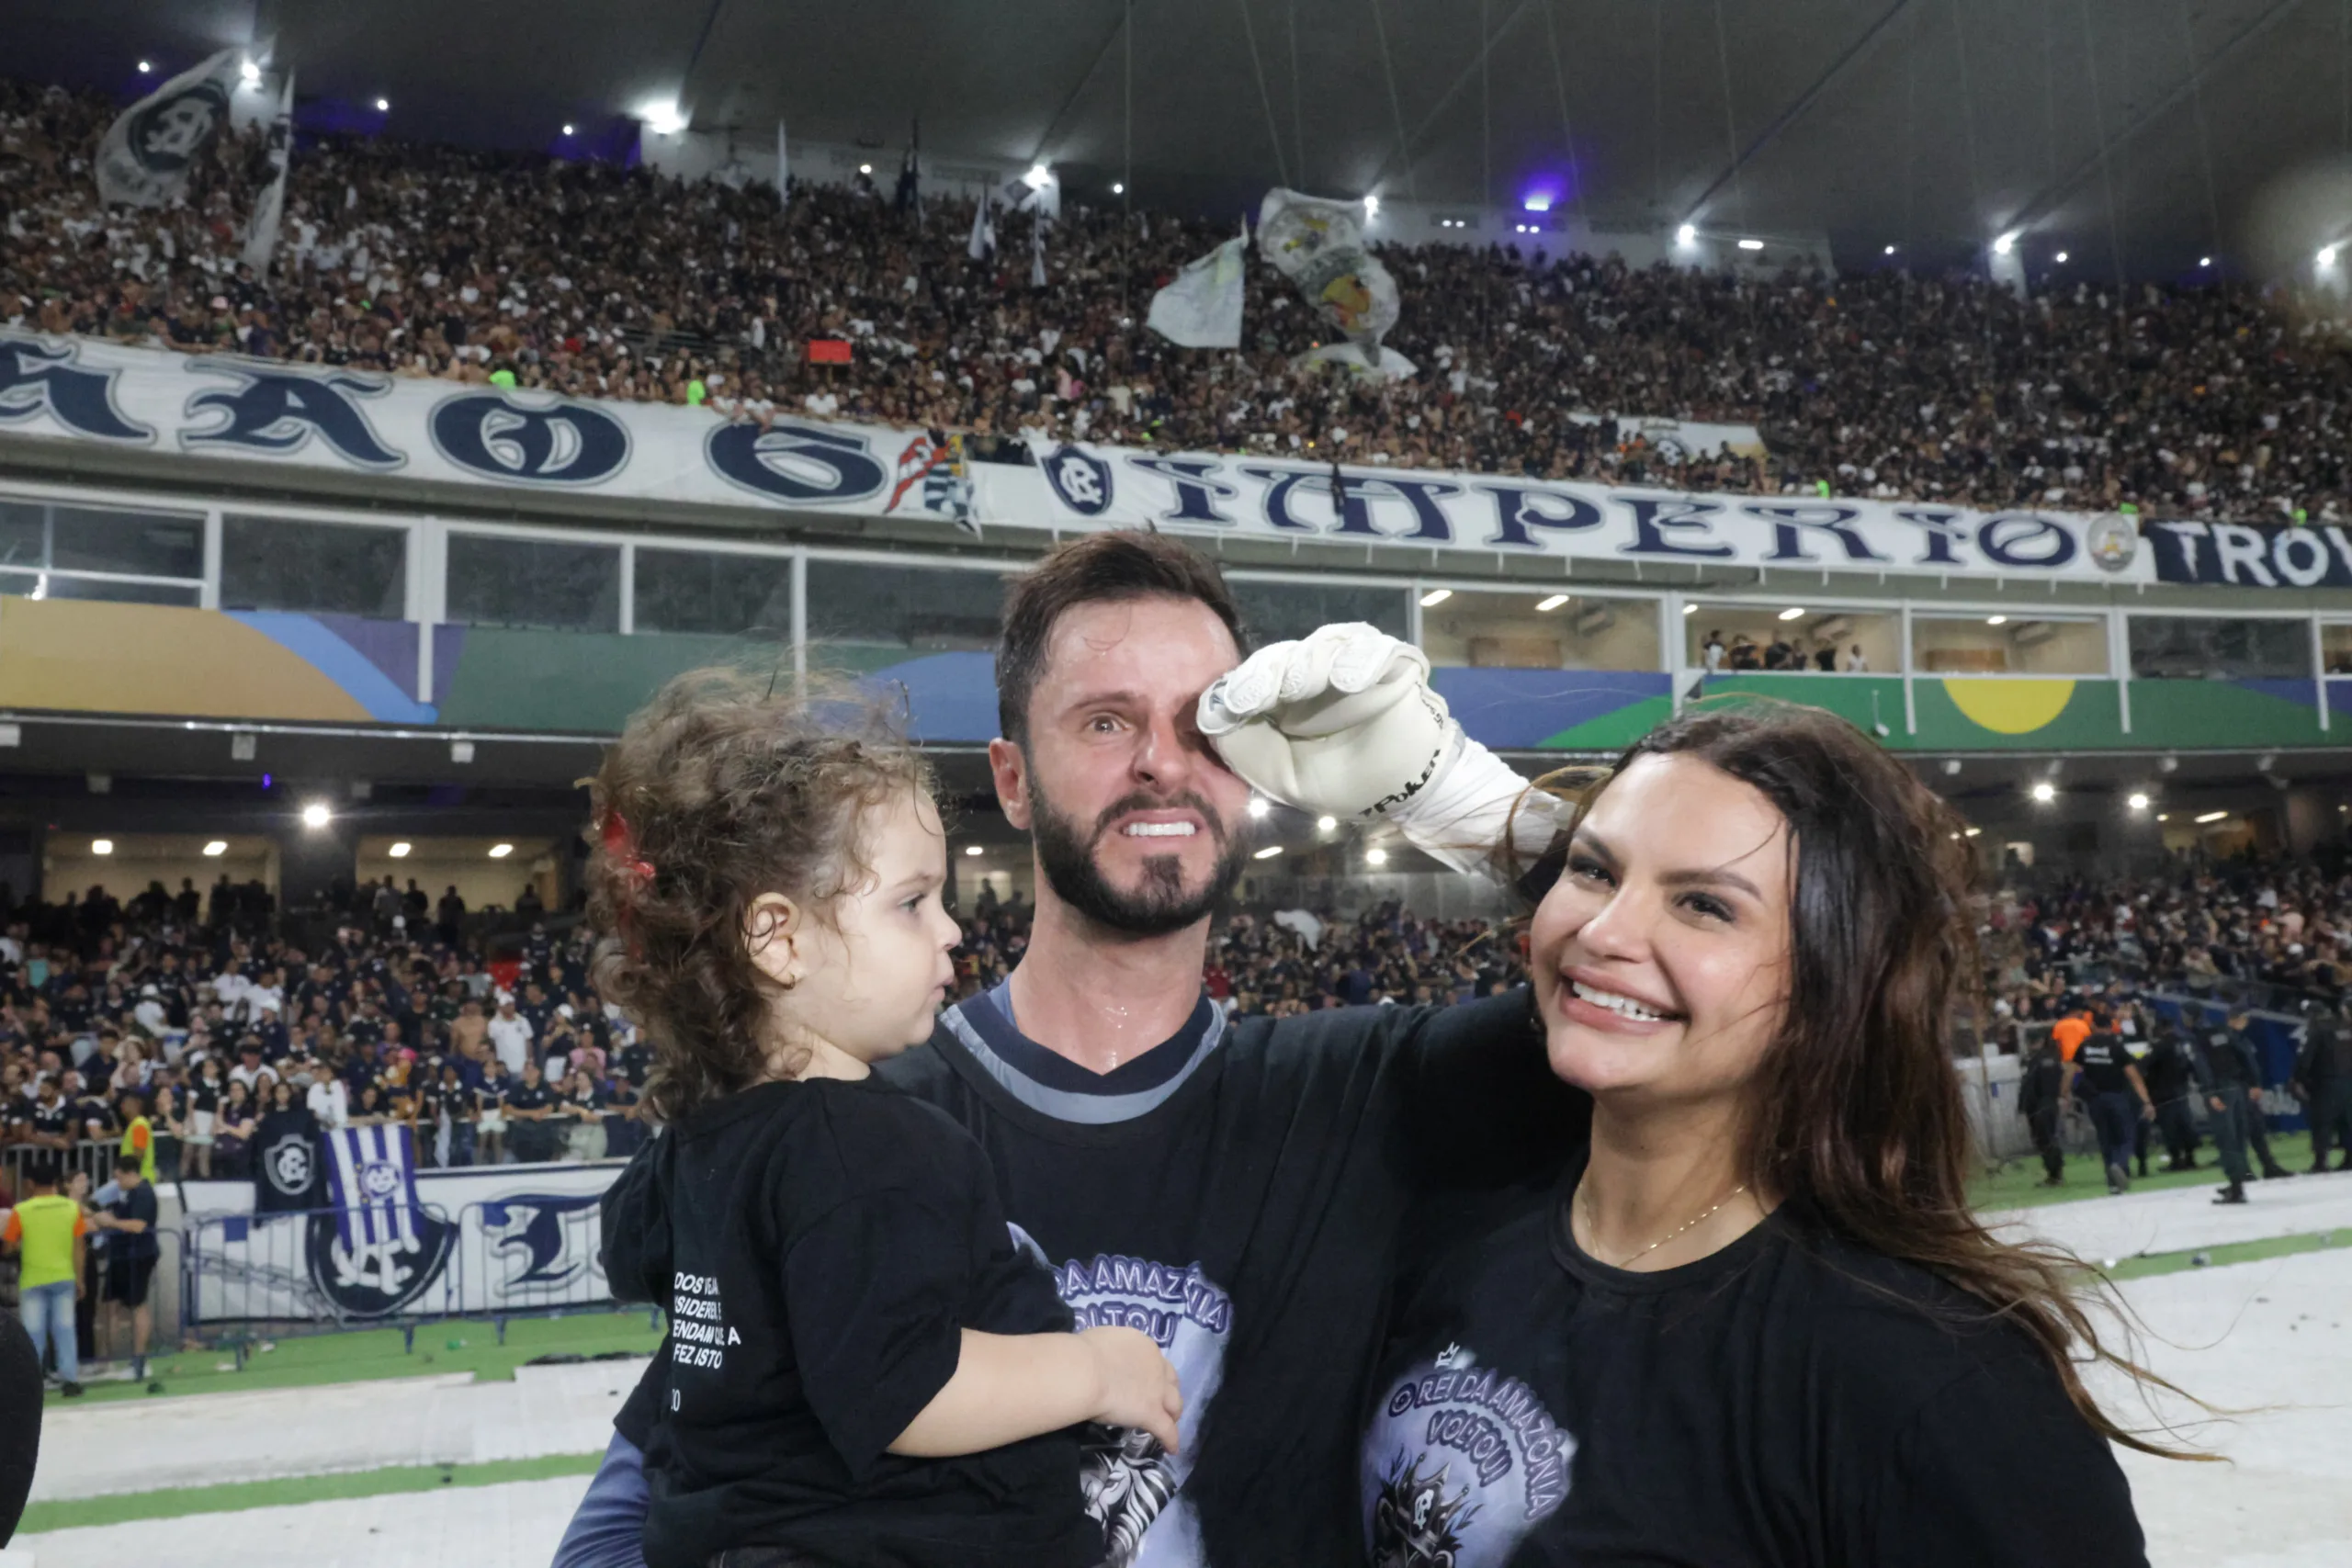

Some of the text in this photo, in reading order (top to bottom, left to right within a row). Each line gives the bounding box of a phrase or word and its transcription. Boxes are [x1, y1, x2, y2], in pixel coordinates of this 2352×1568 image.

[673, 1319, 715, 1346] ENDAM
[728, 1326, 741, 1346] A
[694, 1347, 722, 1370] ISTO
[1415, 1373, 1459, 1407] REI
[1456, 1371, 1494, 1404] DA
